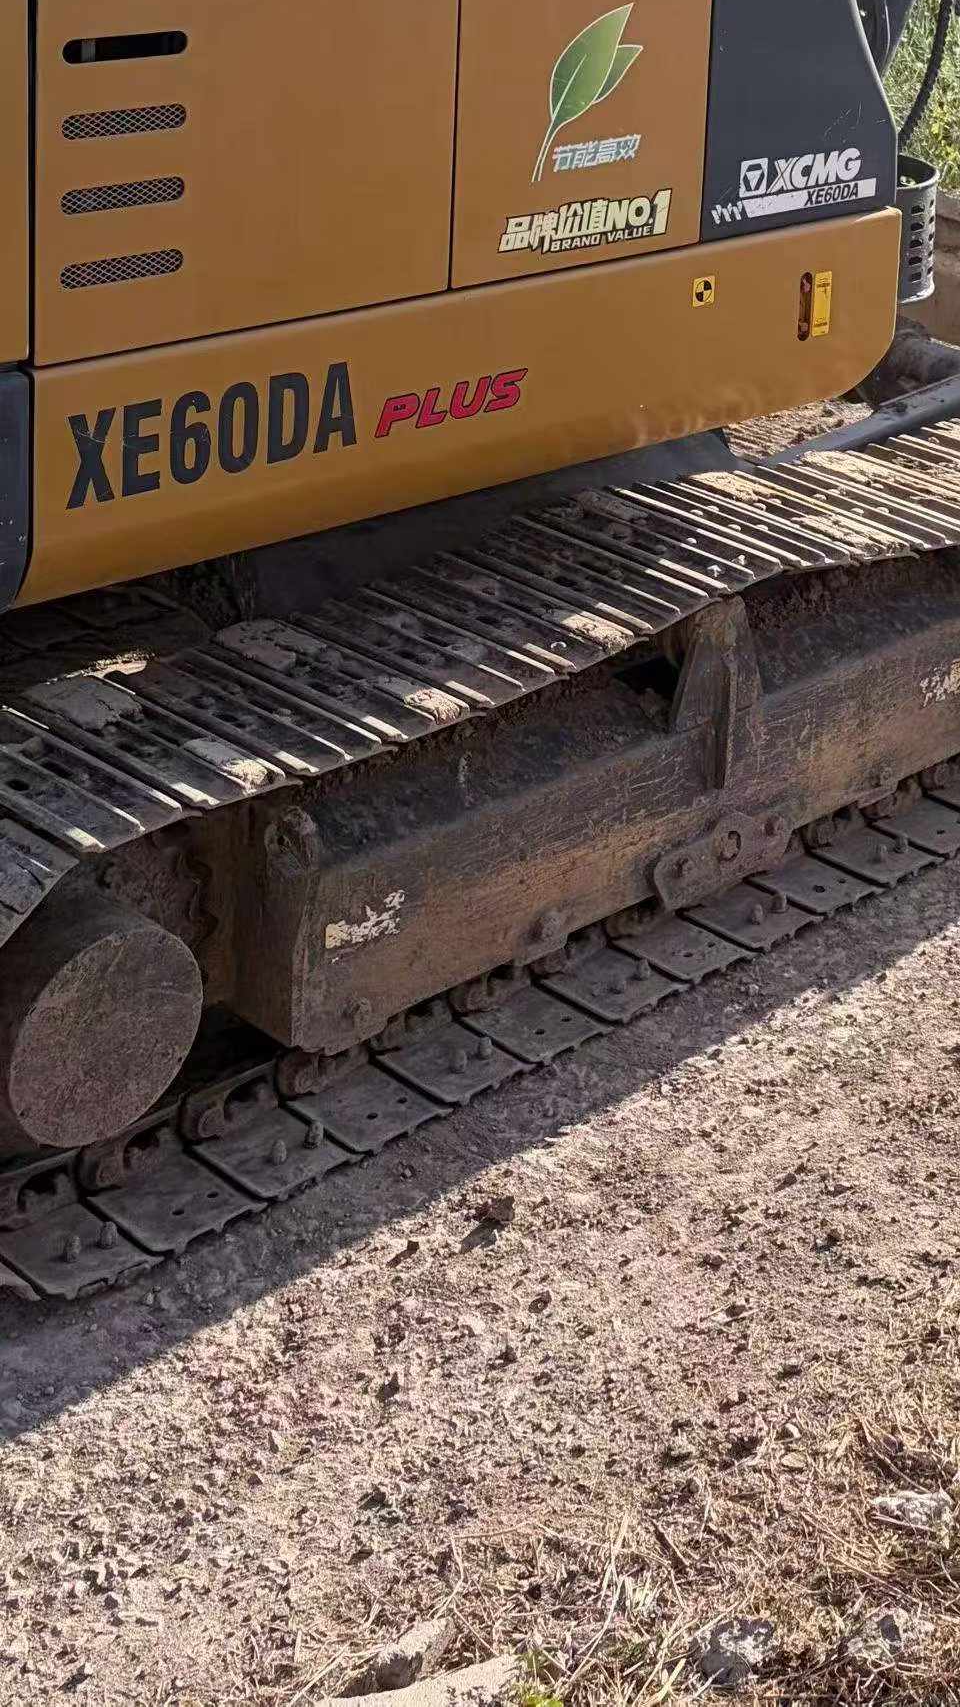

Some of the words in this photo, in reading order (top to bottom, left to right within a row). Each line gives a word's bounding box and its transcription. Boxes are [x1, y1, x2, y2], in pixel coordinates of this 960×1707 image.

[767, 148, 862, 193] XCMG
[804, 182, 859, 207] XE60DA
[551, 234, 601, 252] BRAND
[607, 226, 654, 242] VALUE
[374, 368, 530, 439] PLUS
[66, 362, 358, 510] XE60DA
